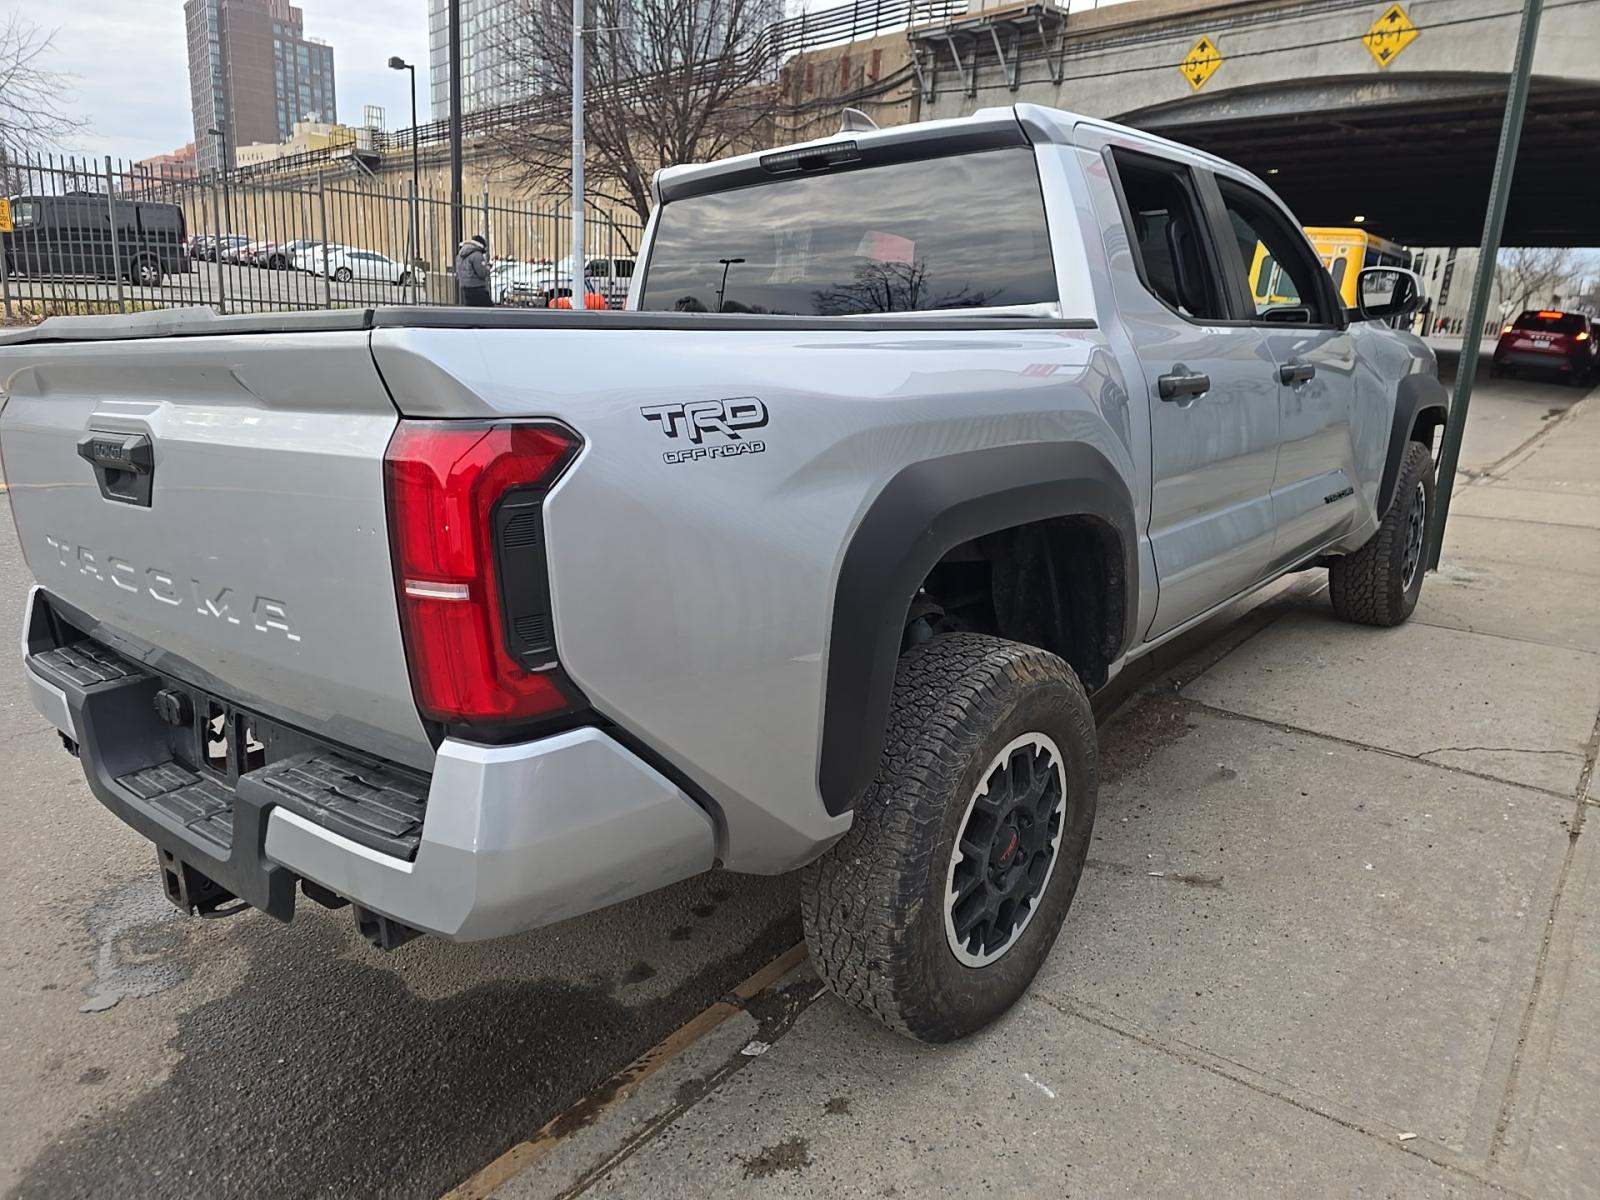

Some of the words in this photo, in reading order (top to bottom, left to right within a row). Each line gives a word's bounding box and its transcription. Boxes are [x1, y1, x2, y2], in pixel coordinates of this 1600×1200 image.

[640, 396, 769, 444] TRD
[663, 448, 707, 464] OFF
[709, 440, 765, 459] ROAD
[45, 534, 301, 642] TACOMA
